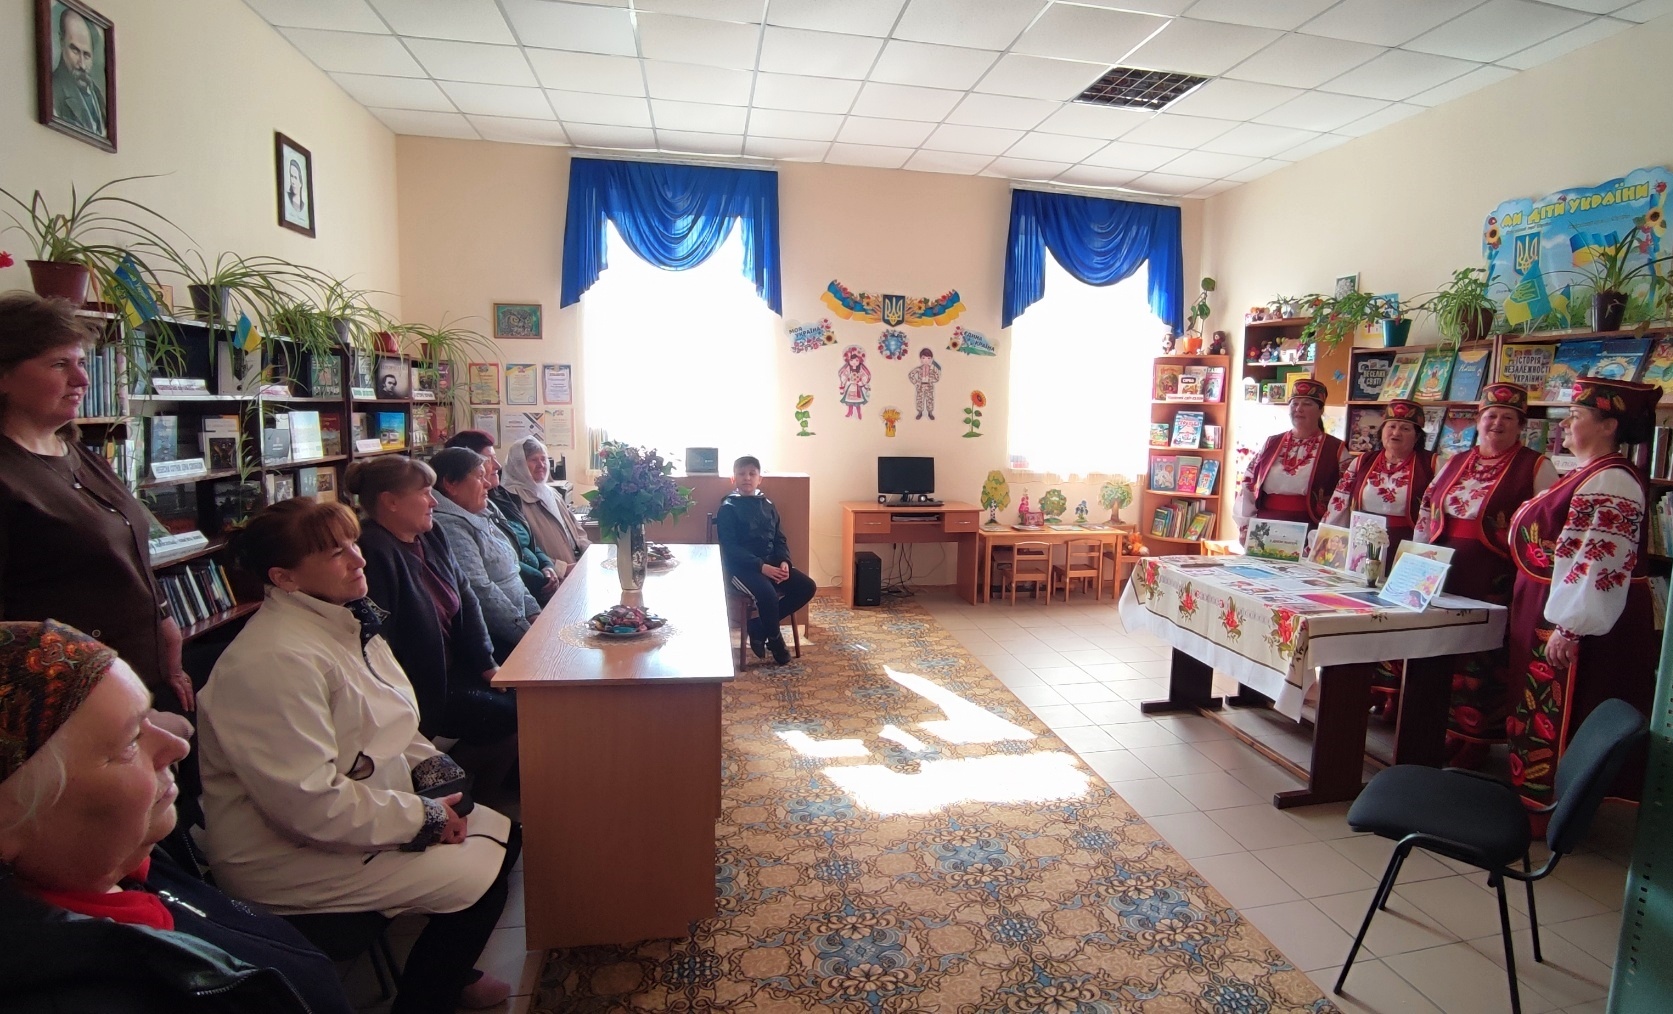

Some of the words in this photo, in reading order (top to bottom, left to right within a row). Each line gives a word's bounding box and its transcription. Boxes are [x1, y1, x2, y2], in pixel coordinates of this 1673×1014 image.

[1527, 202, 1565, 225] ДІТИ
[1569, 181, 1650, 214] УКРАЇНИ
[789, 326, 803, 334] МОЯ
[795, 326, 821, 338] УКРАЇНА
[1515, 356, 1542, 365] ІСТОРІЯ
[1504, 364, 1550, 374] НЕЗАЛЕЖНОСТІ
